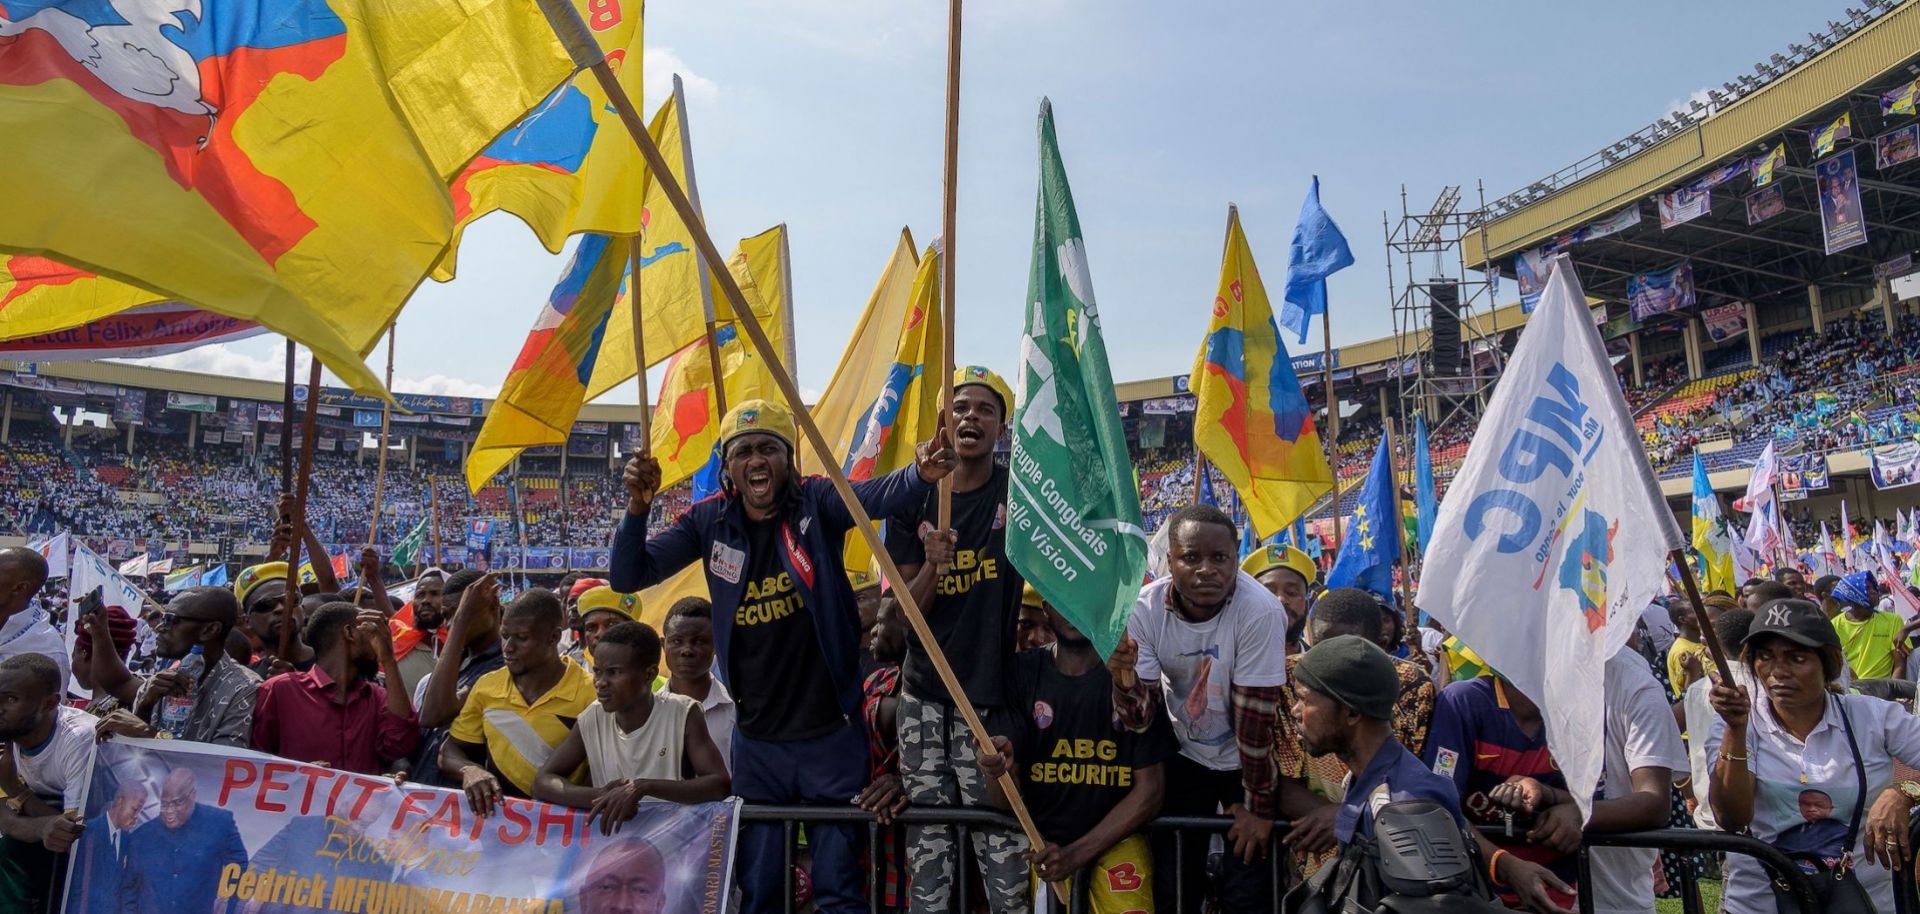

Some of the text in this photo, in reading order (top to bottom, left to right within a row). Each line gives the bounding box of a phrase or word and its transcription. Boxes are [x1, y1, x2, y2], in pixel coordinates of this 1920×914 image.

[87, 318, 143, 342] Félix
[1030, 526, 1078, 582] Vision
[744, 571, 794, 602] ABG
[735, 592, 806, 626] ECURIT
[1051, 738, 1118, 761] ABG
[217, 758, 392, 822] PETIT
[1030, 762, 1132, 787] SECURITE
[315, 815, 481, 878] Excellence
[707, 815, 728, 868] MASTER
[217, 862, 328, 909] Cédrick
